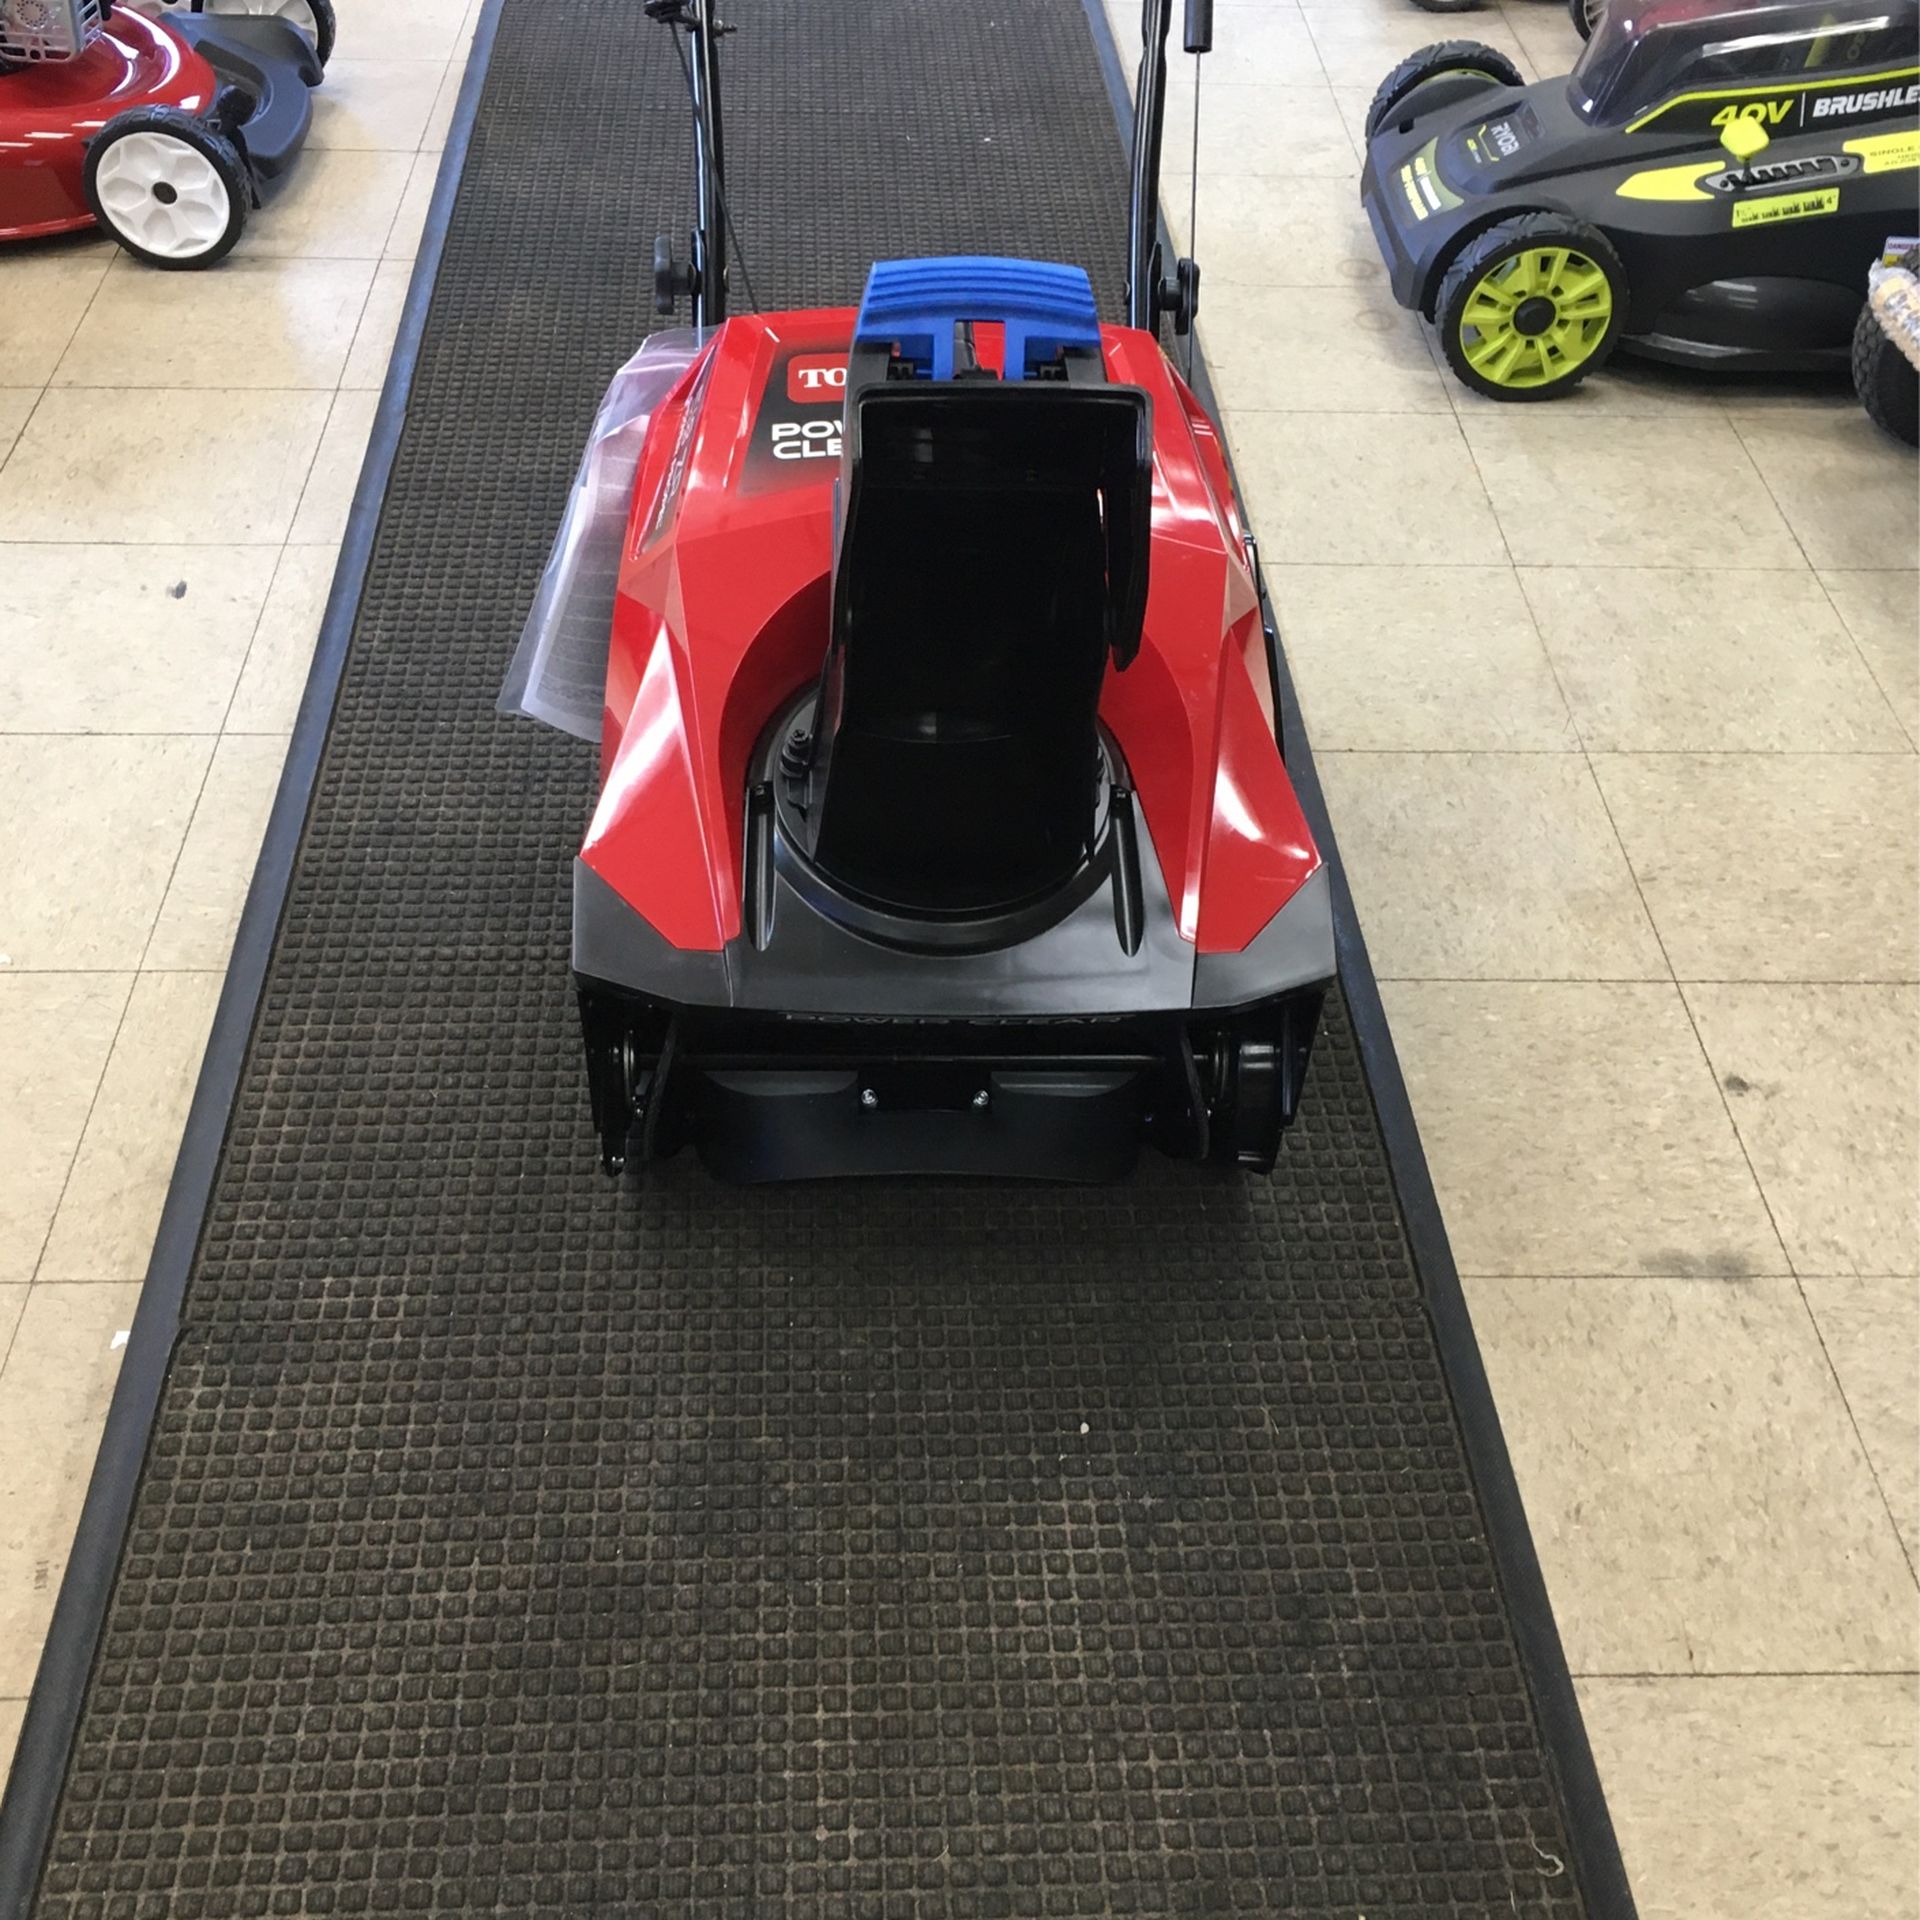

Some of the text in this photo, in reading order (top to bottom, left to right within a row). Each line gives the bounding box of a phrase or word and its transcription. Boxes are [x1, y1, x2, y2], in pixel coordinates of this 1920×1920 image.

[1711, 99, 1794, 126] 40V
[1491, 121, 1521, 156] RYOBI
[798, 367, 847, 388] TO
